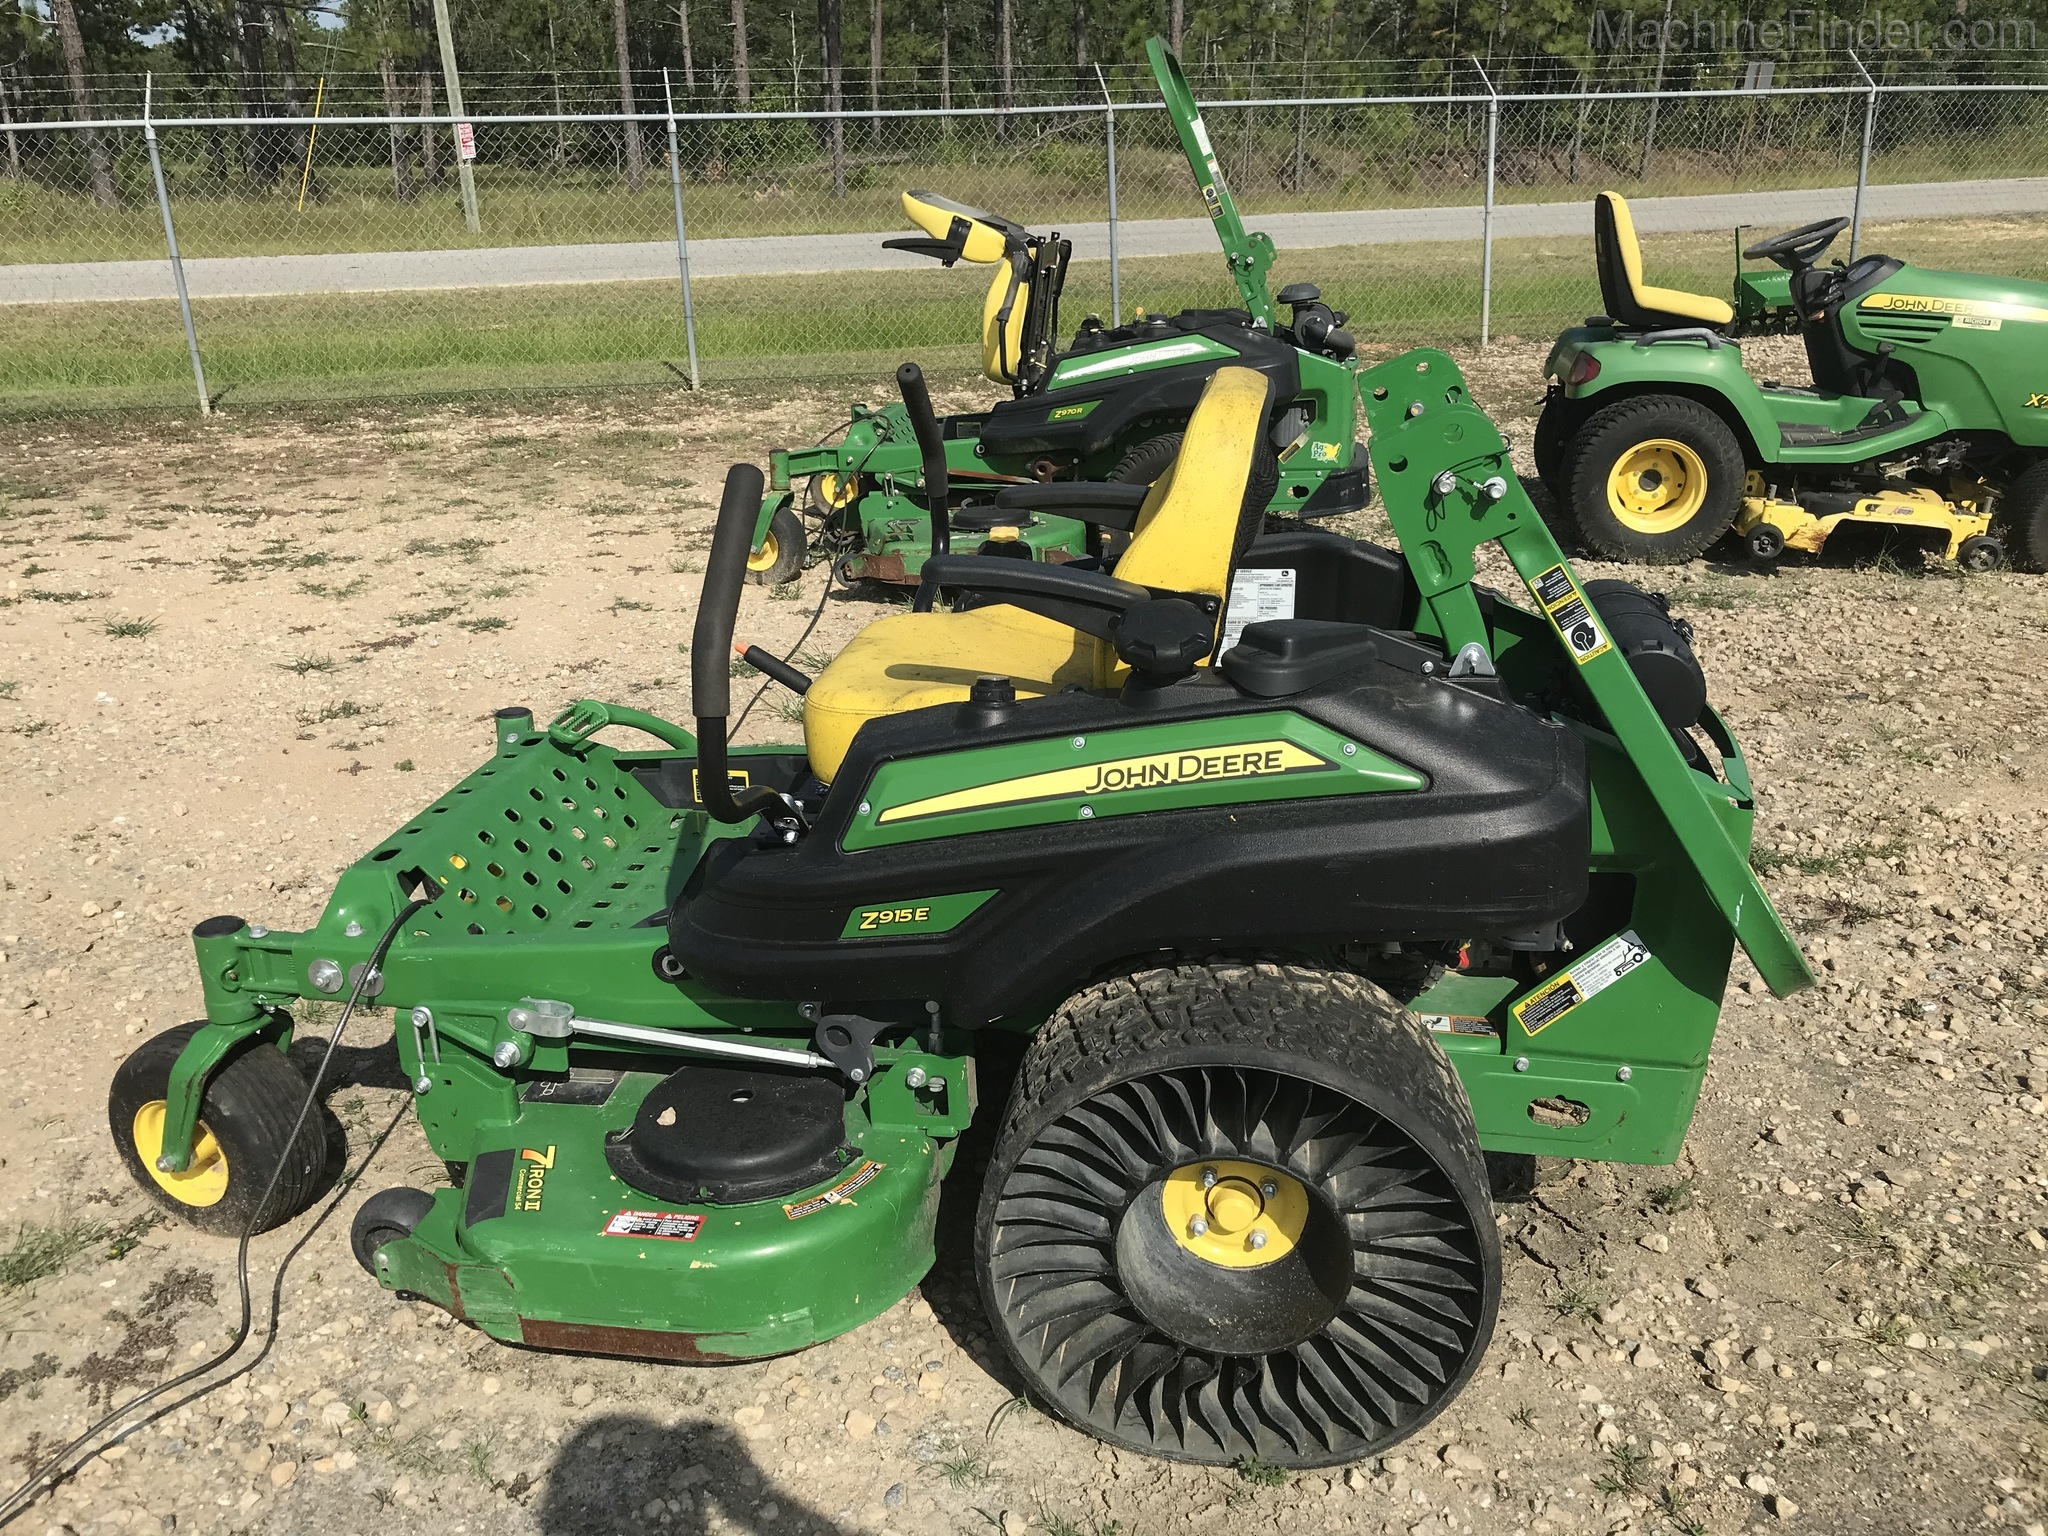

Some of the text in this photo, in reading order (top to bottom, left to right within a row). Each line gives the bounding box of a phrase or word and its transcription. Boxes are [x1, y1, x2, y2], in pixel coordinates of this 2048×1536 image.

[1883, 297, 1928, 310] JOHN
[1055, 408, 1083, 418] Z970R
[1580, 645, 1605, 663] CAUTION
[1086, 750, 1283, 793] JOHN DEERE
[858, 907, 929, 930] Z915E
[1528, 980, 1560, 1004] ATENCIÓN
[514, 1168, 527, 1210] Commercial 54
[632, 1210, 700, 1221] DANGER PELIGRO
